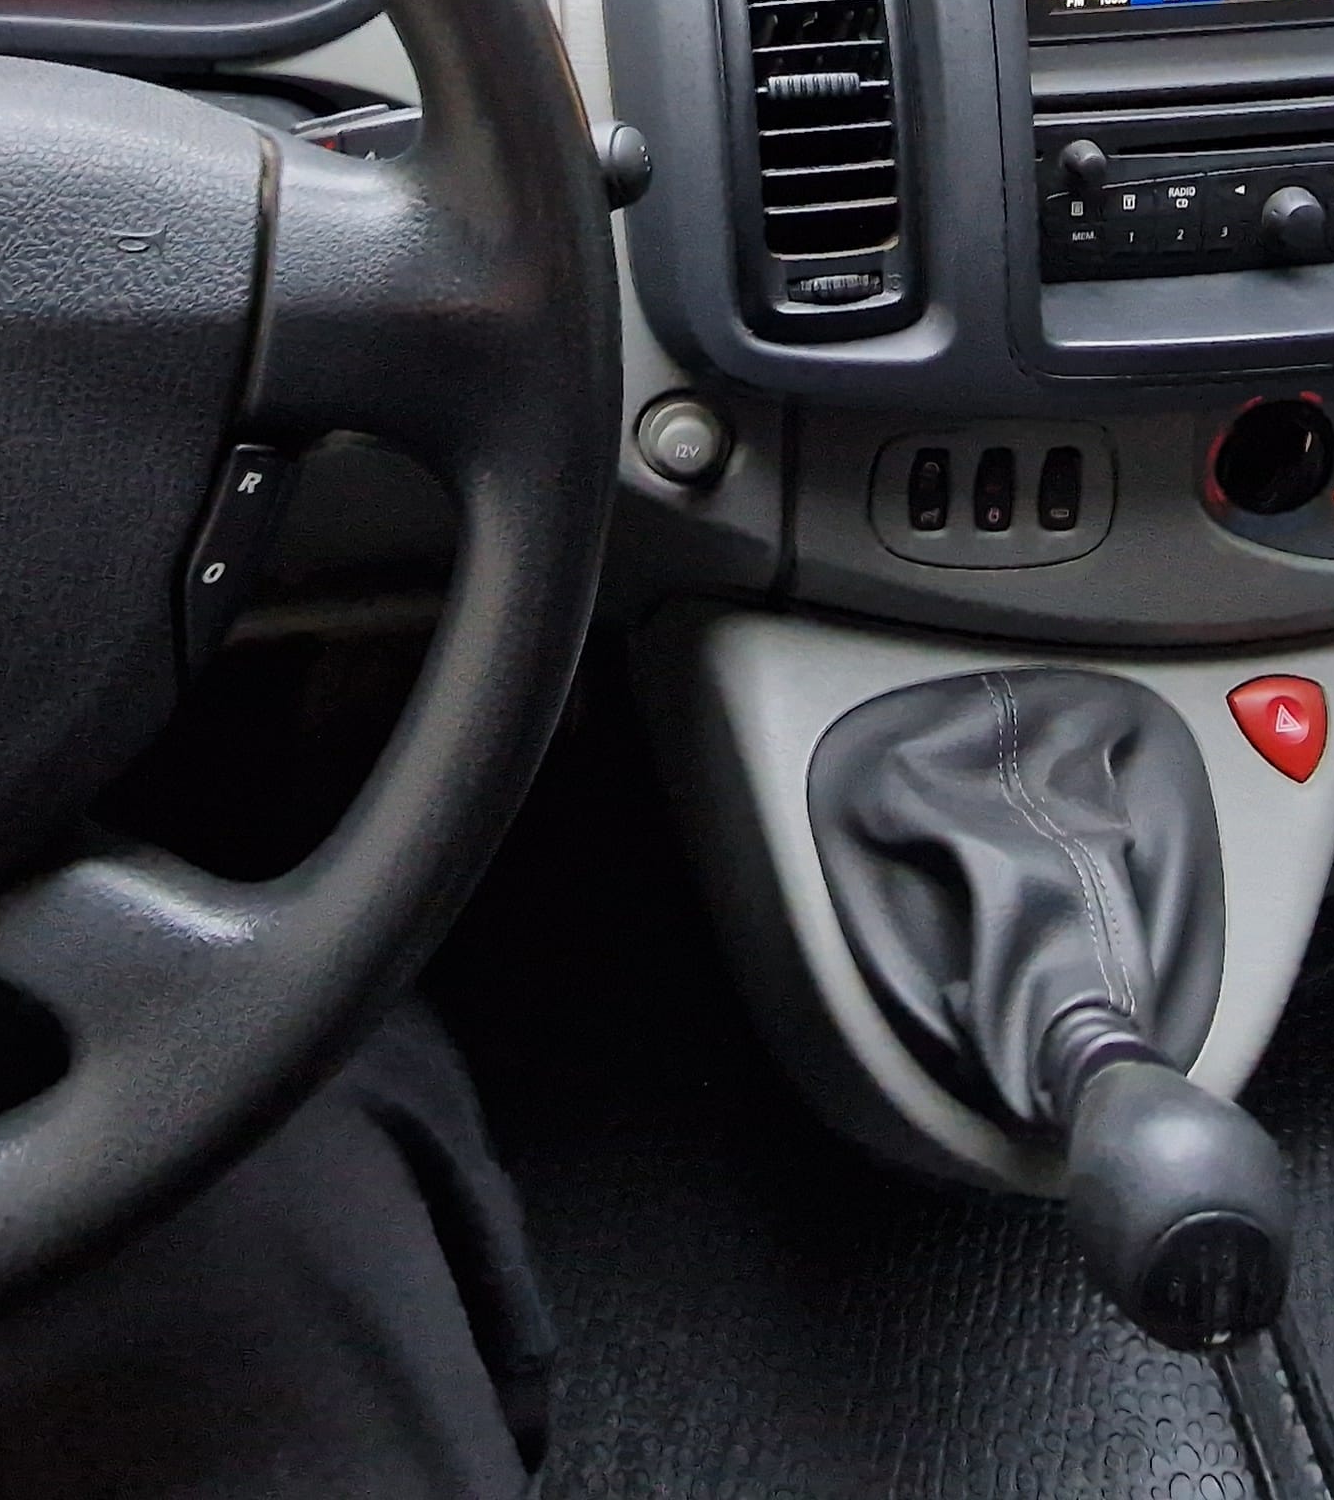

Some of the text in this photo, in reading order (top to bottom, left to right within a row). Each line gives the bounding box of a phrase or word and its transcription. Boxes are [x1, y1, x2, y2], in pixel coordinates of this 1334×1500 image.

[1168, 186, 1196, 197] RADIO
[675, 443, 701, 459] 12V
[237, 471, 263, 494] R
